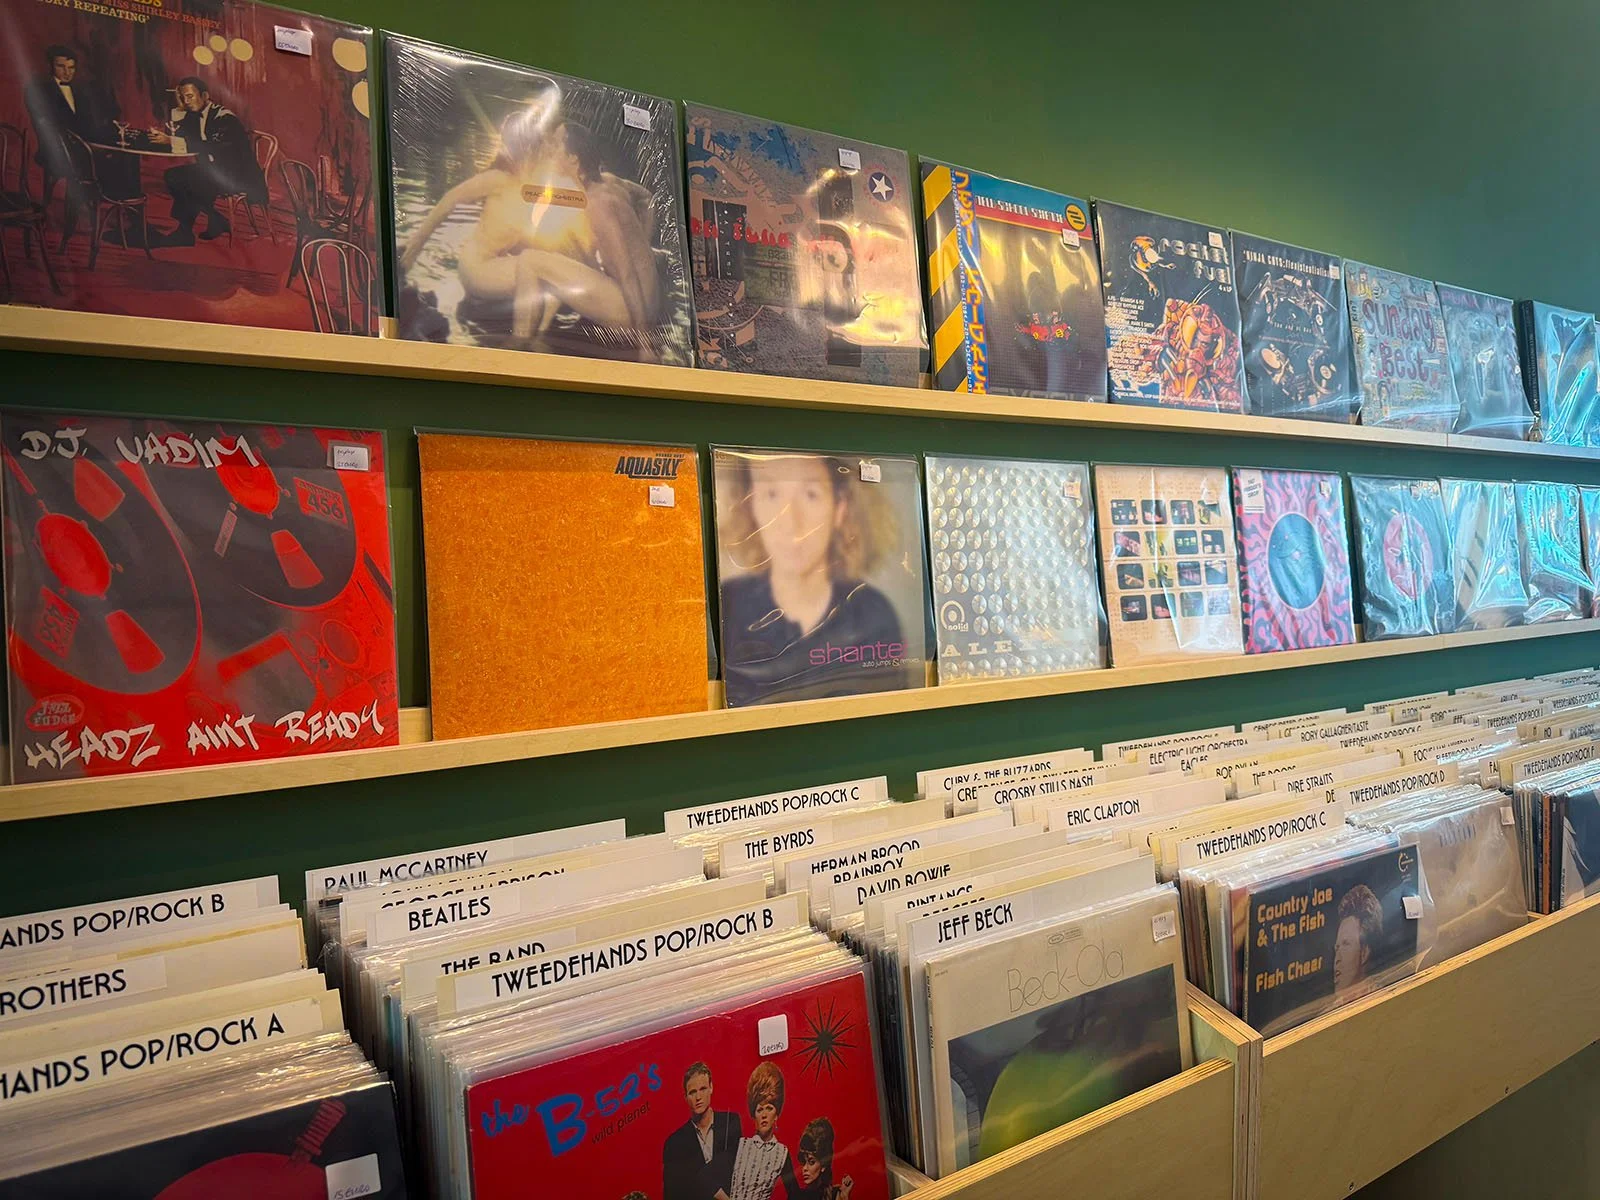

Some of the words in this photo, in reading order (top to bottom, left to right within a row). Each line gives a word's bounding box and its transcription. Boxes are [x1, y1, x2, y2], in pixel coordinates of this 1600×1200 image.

[131, 3, 183, 21] SHIRLEY
[182, 12, 222, 29] BASSEY
[1194, 261, 1232, 285] fuel
[615, 455, 685, 480] AQUASKY
[307, 494, 344, 520] 456
[891, 657, 901, 668] &
[24, 723, 161, 771] HEADZ
[274, 698, 385, 745] READY
[1301, 729, 1319, 743] RORY
[984, 769, 1001, 780] THE
[1523, 754, 1561, 778] TWEEDEHANDS
[1561, 747, 1590, 767] POP/ROCK
[994, 785, 1036, 805] CROSBY
[1069, 774, 1094, 790] NASH
[1305, 772, 1334, 791] STRAITS
[1349, 781, 1401, 805] TWEEDEHANDS
[1401, 772, 1439, 792] POP/ROCK
[1438, 769, 1445, 782] D
[686, 799, 779, 829] TWEEDEHANDS
[782, 789, 849, 812] POP/ROCK
[850, 786, 860, 801] C
[1066, 807, 1091, 826] ERIC
[1093, 799, 1141, 821] CLAPTON
[744, 838, 769, 860] THE
[773, 829, 815, 854] BYRDS
[1196, 826, 1267, 860] TWEEDEHANDS
[1268, 814, 1318, 838] POP/ROCK
[1318, 811, 1327, 826] C
[324, 870, 368, 893] PAUL
[379, 849, 489, 883] MCCARTNEY
[811, 851, 867, 875] HERMAN
[871, 839, 920, 861] BROOD
[857, 878, 901, 905] DAVID
[1256, 892, 1309, 925] Country
[1312, 887, 1333, 909] Joe
[73, 896, 205, 937] POP/ROCK
[211, 893, 226, 914] B
[408, 895, 492, 932] BEATLES
[938, 915, 970, 944] JEFF
[975, 902, 1014, 932] BECK
[1256, 929, 1269, 948] &
[1270, 920, 1297, 941] The
[1299, 911, 1325, 935] Fish
[441, 954, 481, 975] THE
[490, 938, 648, 998] TWEEDEHANDS
[654, 911, 757, 957] POP/ROCK
[762, 908, 775, 929] B
[1007, 941, 1125, 1014] Beck-Ola
[1255, 970, 1285, 993] Fish
[1286, 955, 1324, 983] Cheer
[100, 1016, 258, 1076] POP/ROCK
[266, 1012, 286, 1037] A
[480, 1098, 530, 1138] the
[535, 1062, 664, 1158] B-52's
[591, 1122, 614, 1146] wild
[616, 1101, 651, 1131] planet
